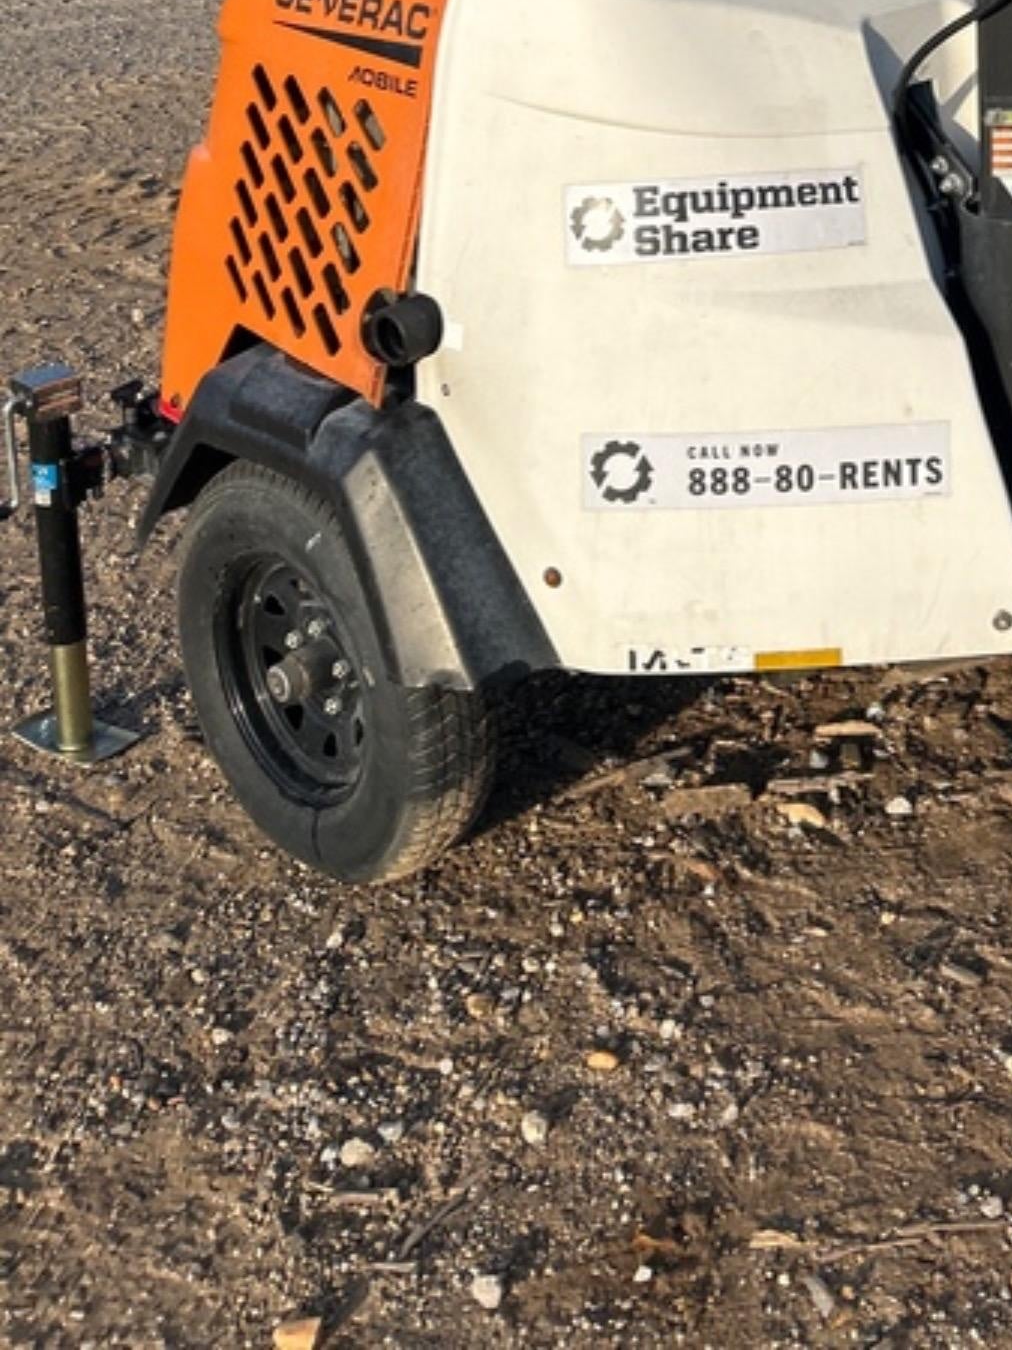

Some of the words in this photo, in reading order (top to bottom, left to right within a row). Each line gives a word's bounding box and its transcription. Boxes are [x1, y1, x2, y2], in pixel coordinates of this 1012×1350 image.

[631, 175, 861, 223] Equipment
[632, 223, 761, 256] Share
[686, 445, 731, 460] CALL
[740, 443, 779, 459] NOW
[687, 456, 944, 495] 888-80-RENTS
